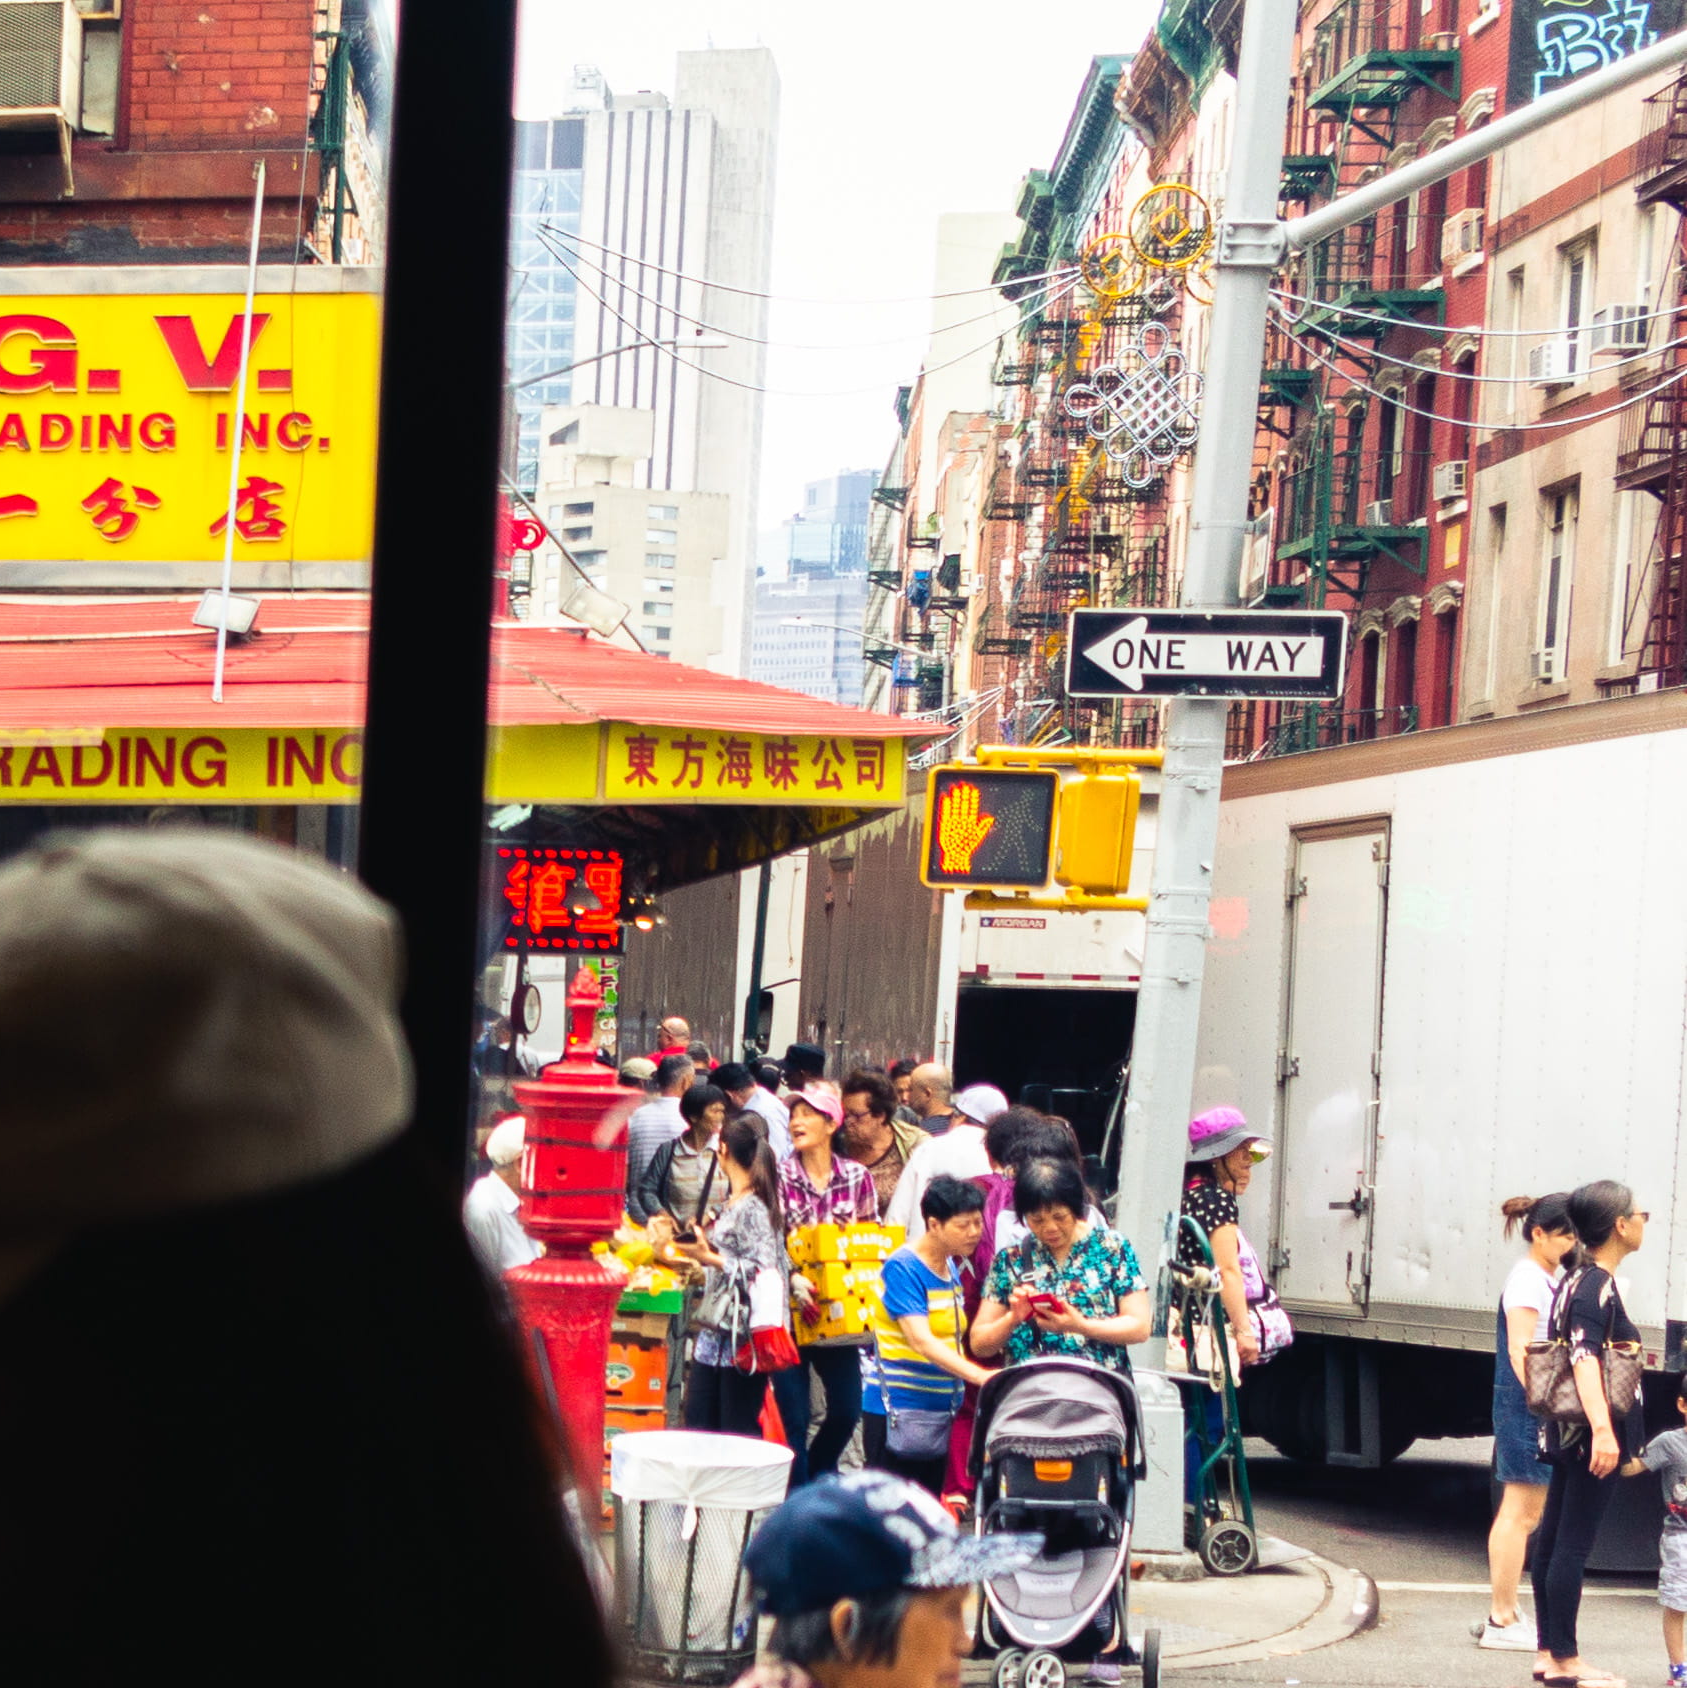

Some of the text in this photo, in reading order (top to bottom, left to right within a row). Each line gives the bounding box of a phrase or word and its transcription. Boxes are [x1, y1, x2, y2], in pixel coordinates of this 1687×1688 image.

[153, 313, 292, 392] V.
[216, 411, 330, 452] INC.
[1112, 638, 1307, 673] ONE WAY
[624, 731, 887, 792] 東方海味公司
[992, 918, 1045, 929] MORGAN
